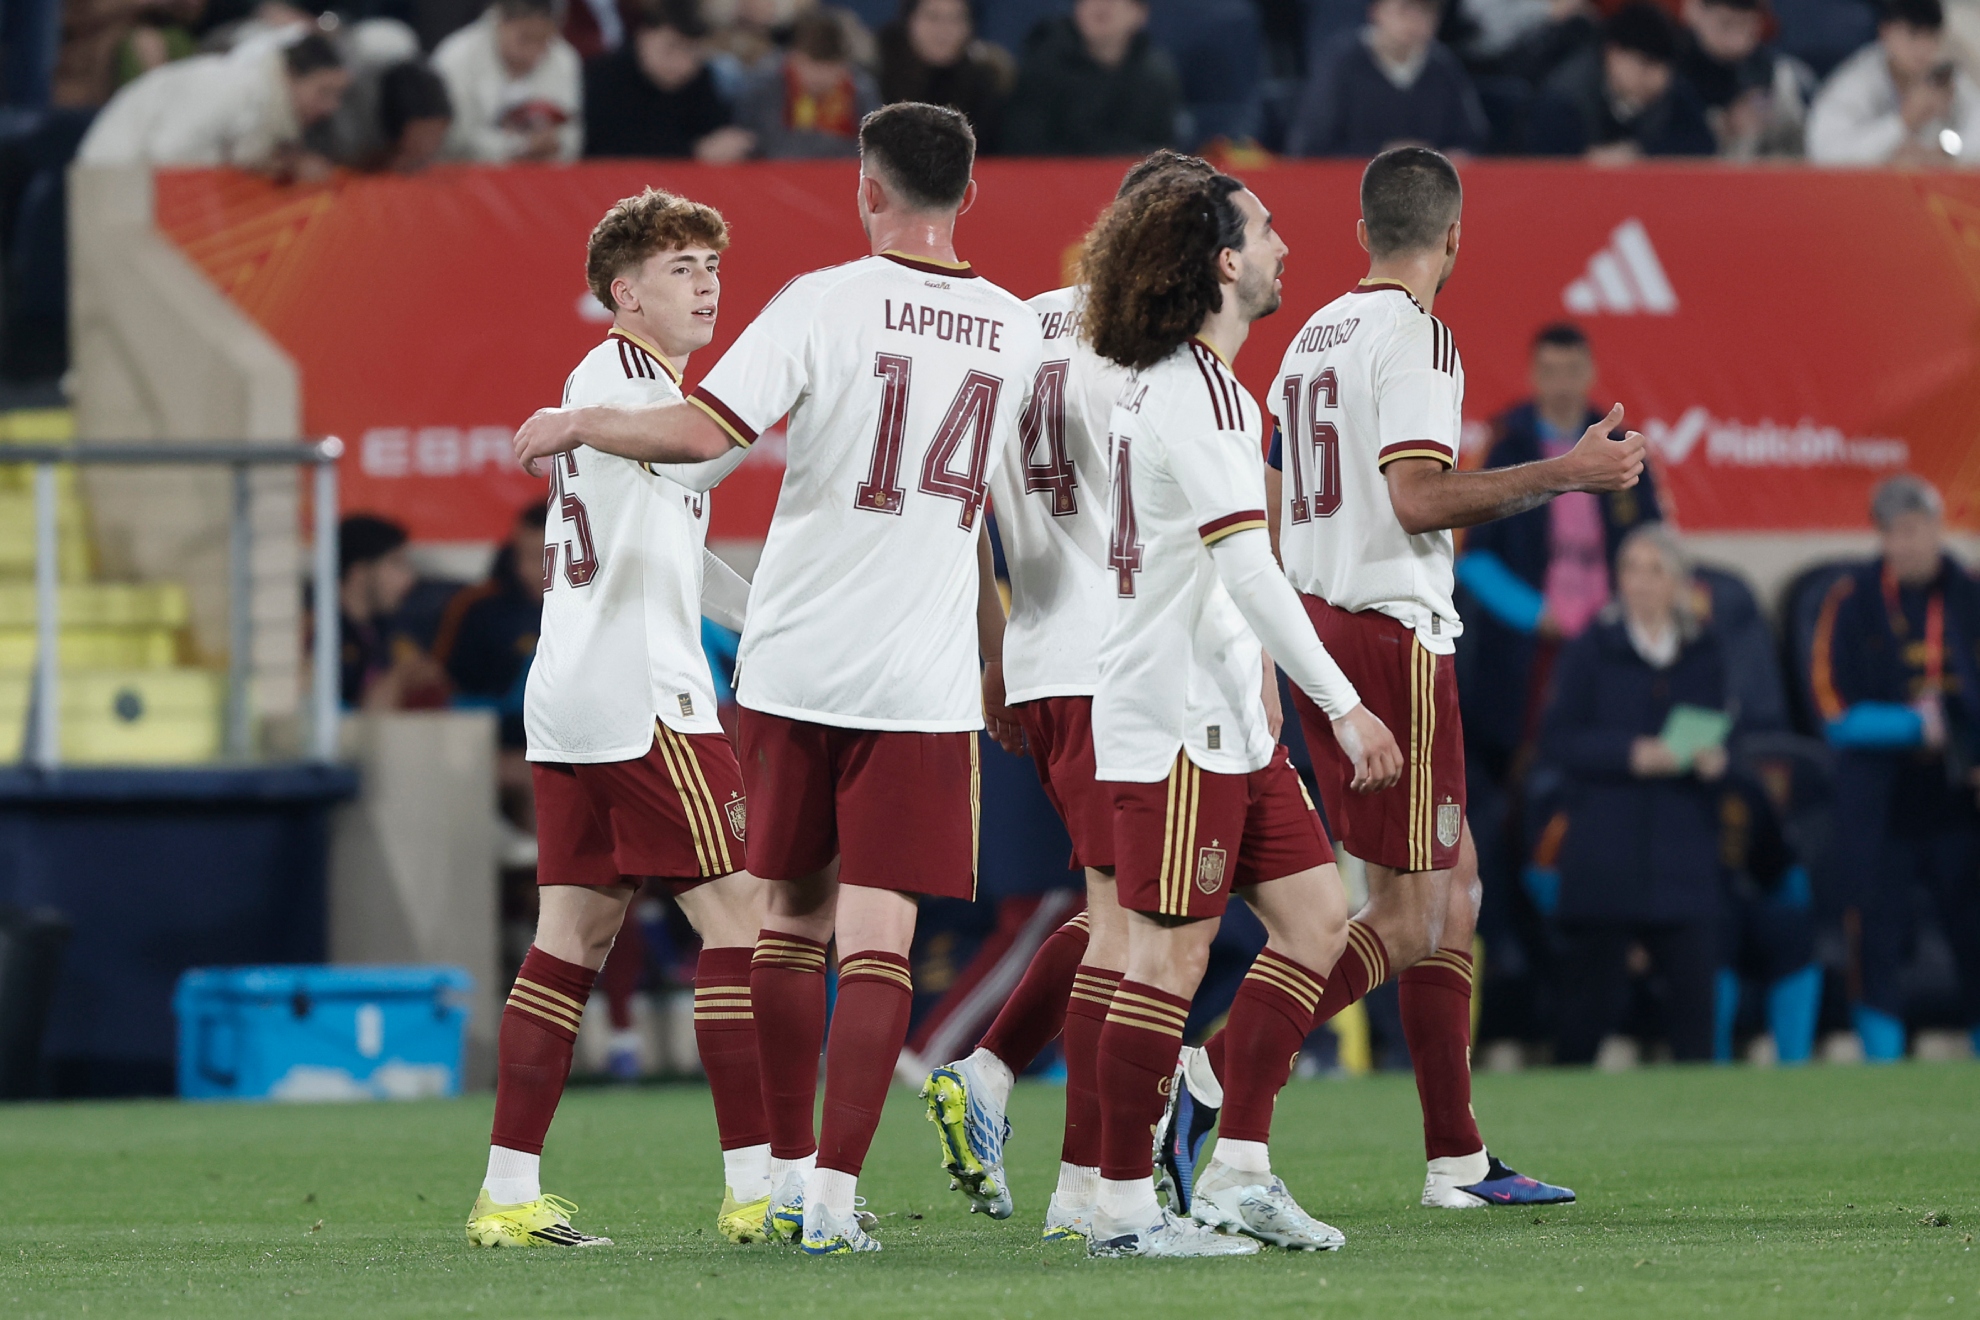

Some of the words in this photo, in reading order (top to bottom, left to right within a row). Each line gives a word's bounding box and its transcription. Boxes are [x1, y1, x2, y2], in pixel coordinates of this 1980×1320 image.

[885, 299, 1004, 353] LAPORTE
[360, 426, 518, 478] EBR
[853, 351, 1004, 533] 14
[1107, 432, 1145, 599] 4
[1282, 366, 1343, 525] 16
